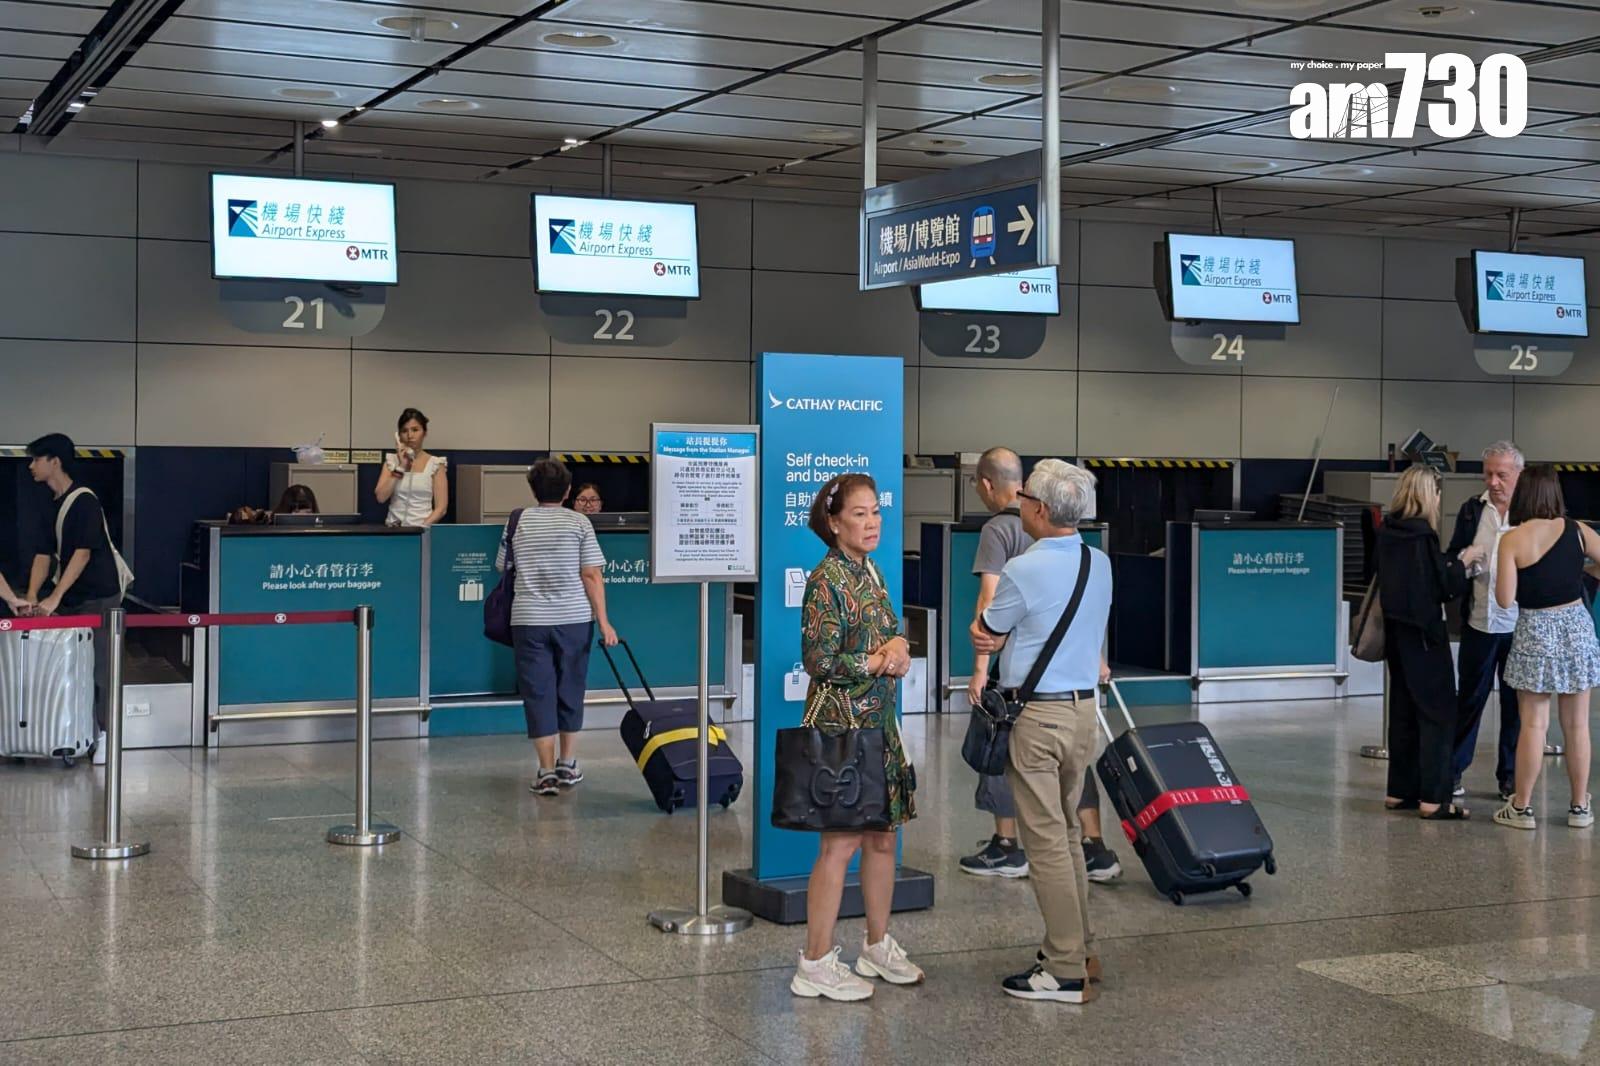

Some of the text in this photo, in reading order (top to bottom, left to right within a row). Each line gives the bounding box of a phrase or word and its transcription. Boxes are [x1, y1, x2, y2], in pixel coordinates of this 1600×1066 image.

[261, 201, 346, 226] 機場快綫
[262, 223, 346, 241] Airport Express
[880, 214, 960, 256] 機場/博覽館
[361, 248, 388, 260] MTR
[579, 241, 653, 258] Airport Express
[667, 265, 691, 276] MTR
[873, 259, 898, 277] Airport
[903, 251, 960, 271] AsiaWorld-Expo
[1204, 274, 1262, 288] Airport Express
[1031, 283, 1052, 294] MTR
[1273, 294, 1292, 303] MTR
[1506, 290, 1556, 302] Airport Express
[283, 296, 324, 329] 21
[1565, 309, 1582, 318] MTR
[593, 309, 634, 341] 22
[965, 324, 1000, 353] 23
[1211, 333, 1245, 361] 24
[1508, 344, 1538, 371] 25
[786, 398, 883, 411] CATHAY PACIFIC
[663, 446, 685, 454] Message
[786, 453, 869, 467] Self check-in
[786, 469, 811, 482] and
[269, 562, 374, 579] 請小心看管行李
[1285, 567, 1310, 575] baggage
[262, 580, 382, 590] Please look after your baggage
[610, 575, 626, 583] look
[627, 575, 643, 583] after
